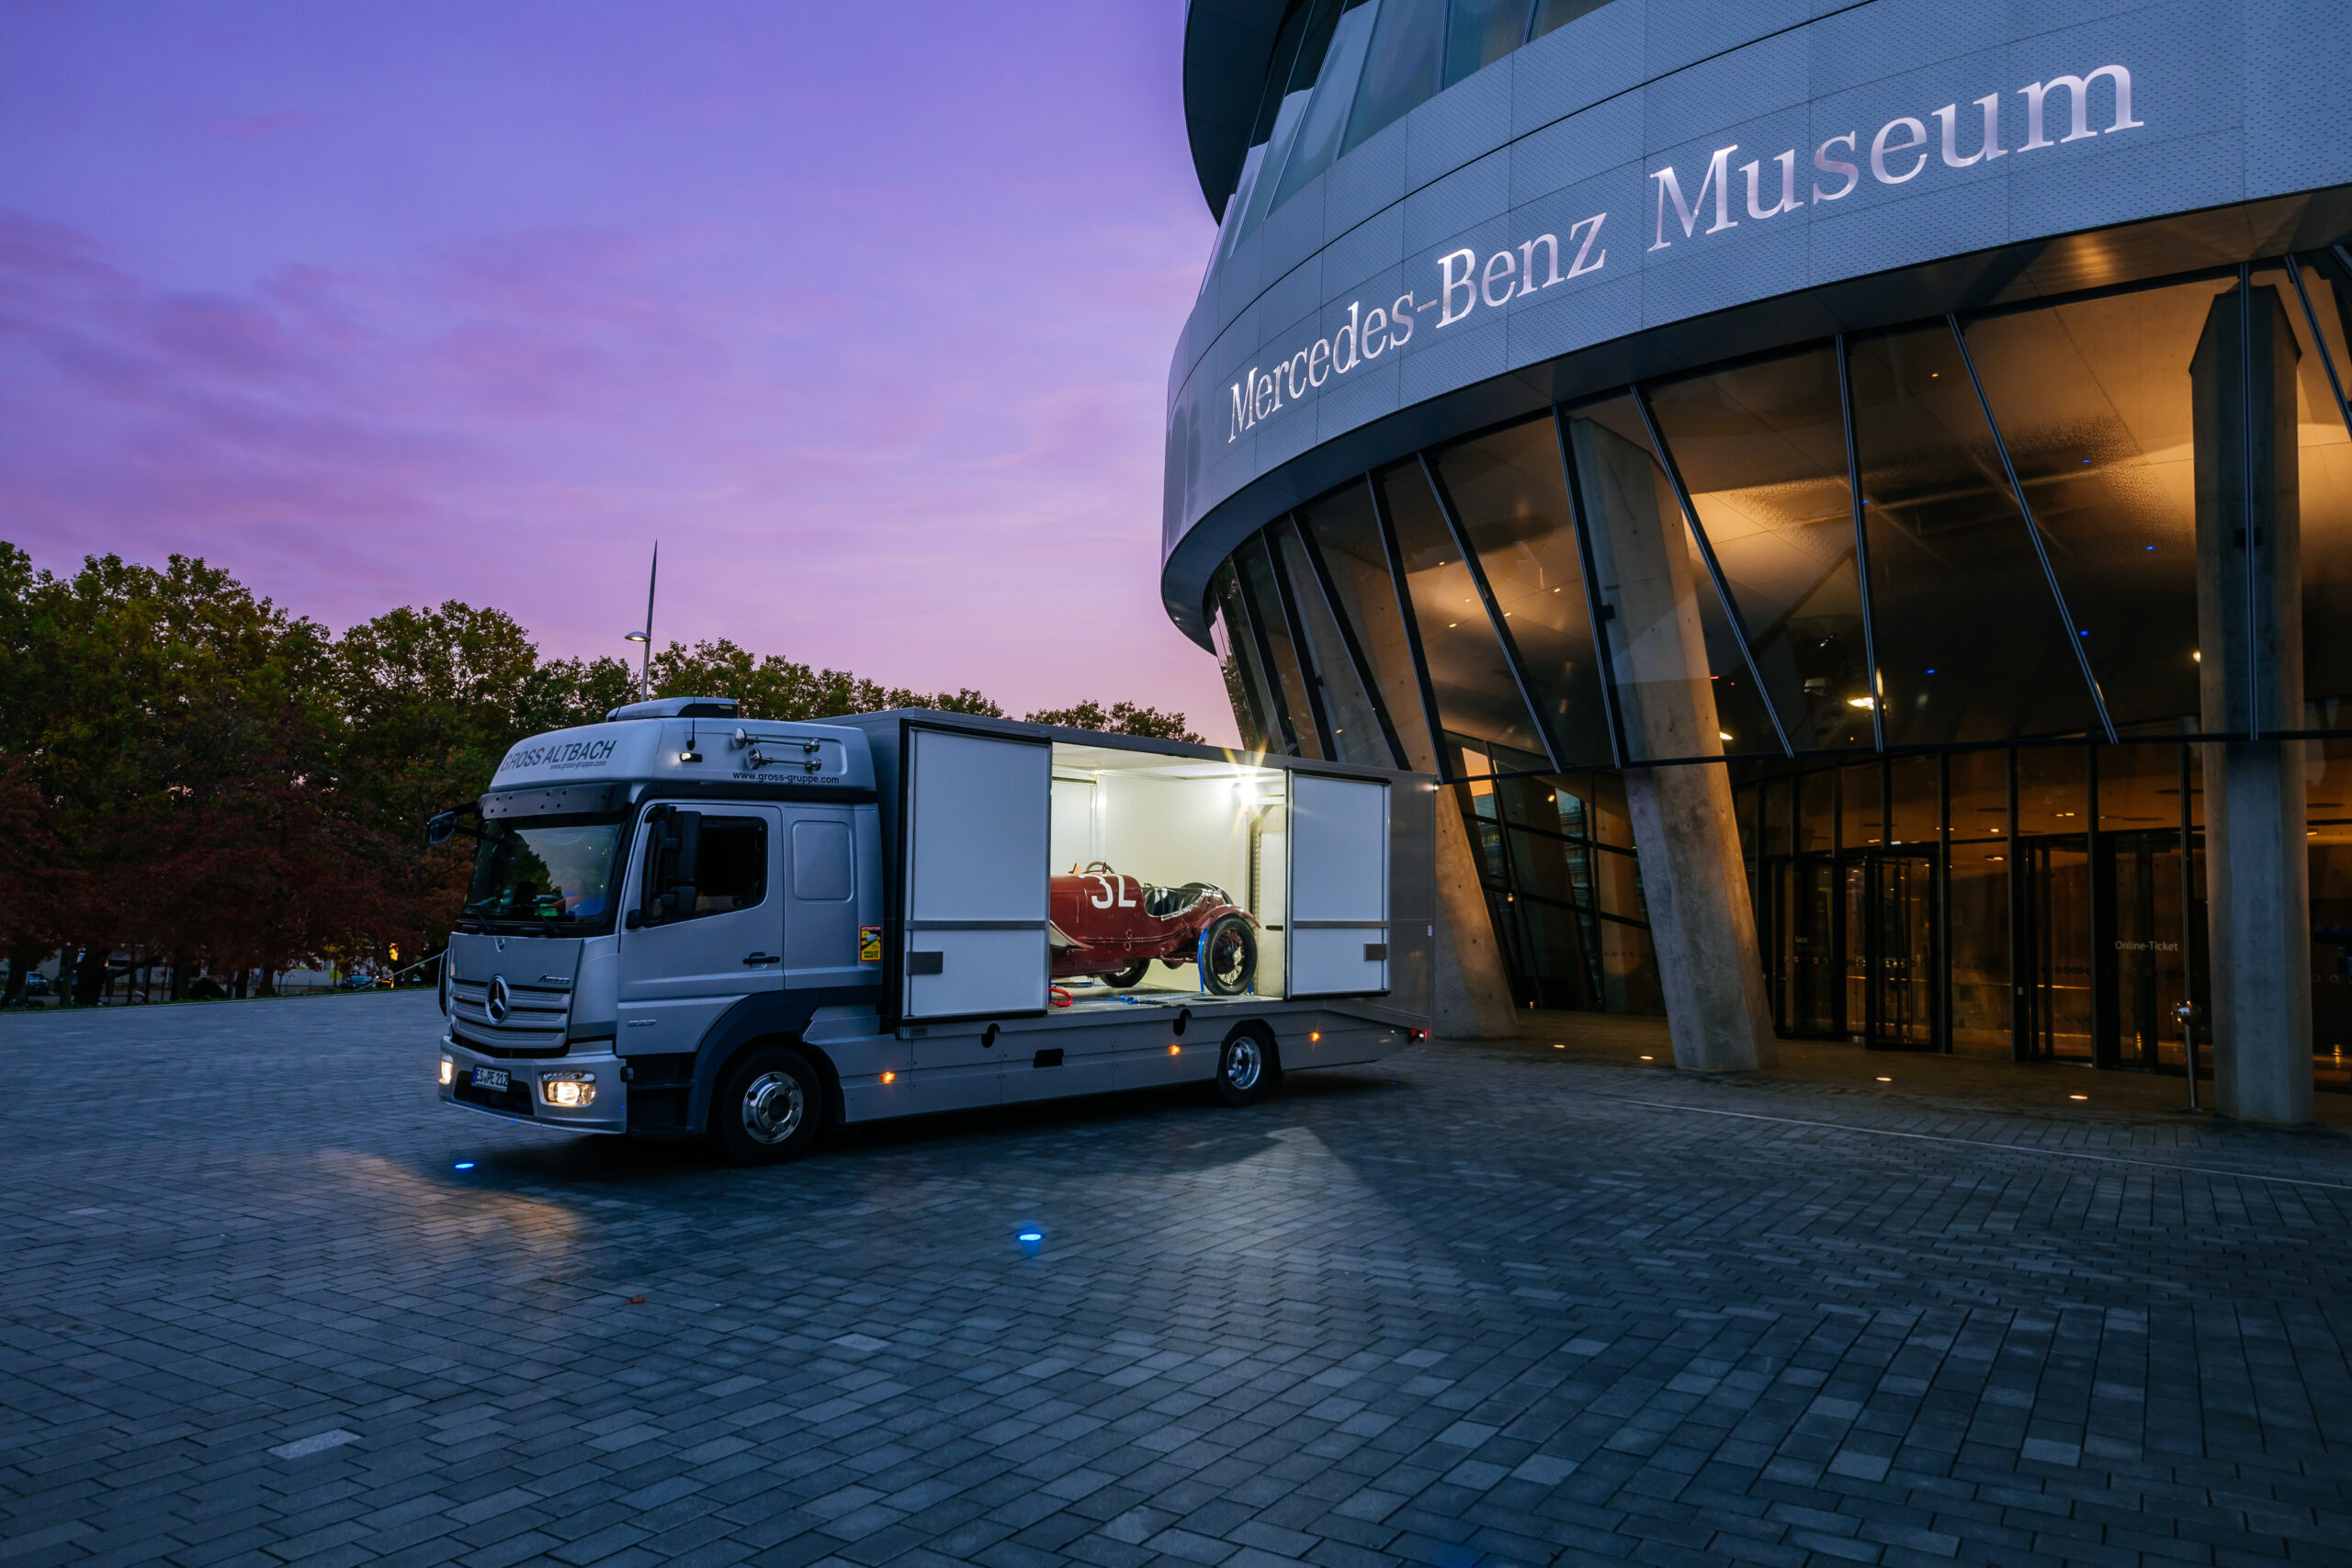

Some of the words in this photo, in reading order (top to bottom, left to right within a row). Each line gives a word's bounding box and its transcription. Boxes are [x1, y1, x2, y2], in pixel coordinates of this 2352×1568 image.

[1227, 213, 1607, 443] Mercedes-Benz
[1647, 64, 2144, 252] Museum
[501, 748, 545, 772] GROSS
[542, 740, 617, 764] ALTBACH
[732, 772, 840, 784] www.gross-gruppe.com
[2115, 940, 2178, 952] Online-Ticket
